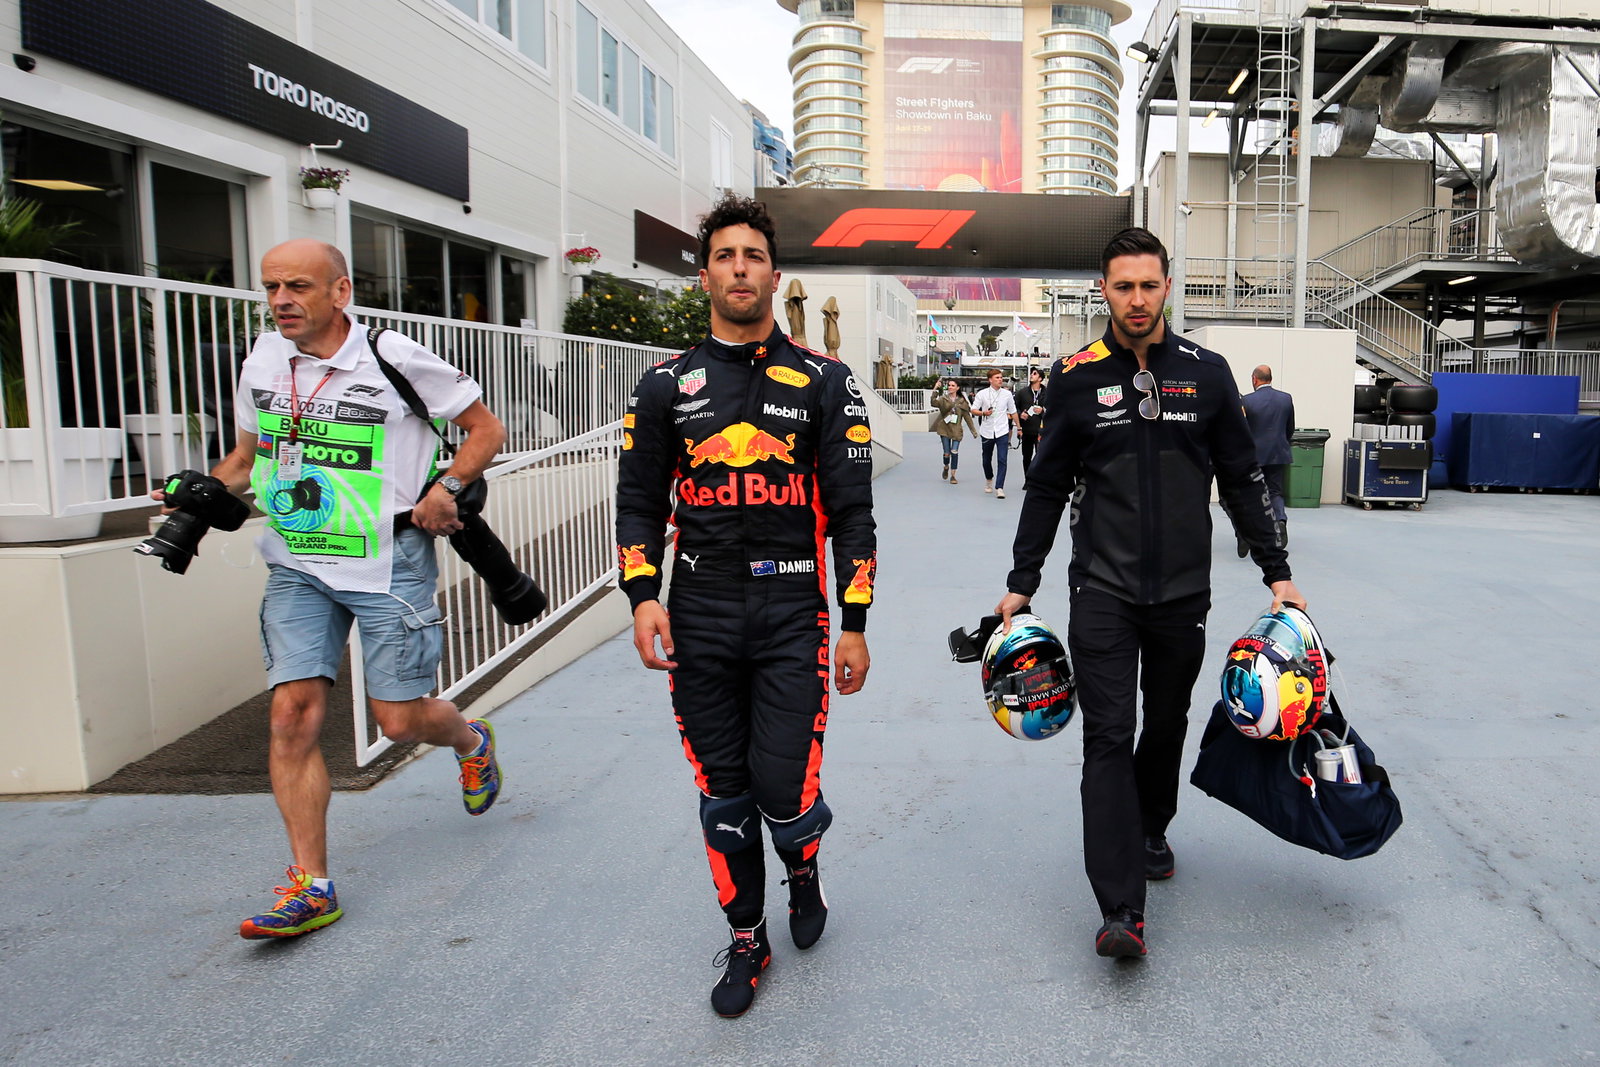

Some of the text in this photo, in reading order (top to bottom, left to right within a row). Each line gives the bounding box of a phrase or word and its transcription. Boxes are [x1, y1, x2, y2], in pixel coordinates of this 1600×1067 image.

[248, 62, 370, 133] TORO ROSSO
[896, 96, 928, 107] Street
[896, 108, 992, 120] Showdown in Baku
[811, 208, 976, 249] F1
[916, 324, 976, 334] MRIOTT
[680, 370, 704, 382] TAG
[778, 370, 805, 384] RAUCH
[1100, 387, 1120, 396] TAG
[317, 404, 334, 416] 24
[690, 412, 714, 420] MARTIN
[763, 403, 798, 420] Mobil
[1162, 412, 1188, 421] Mobil
[303, 444, 359, 464] HOTO
[680, 472, 806, 506] Red Bull
[779, 560, 814, 573] DANIEL
[1244, 639, 1264, 652] Red
[1306, 649, 1326, 692] Bull
[1018, 691, 1050, 703] MARTIN
[1028, 699, 1049, 712] Bull
